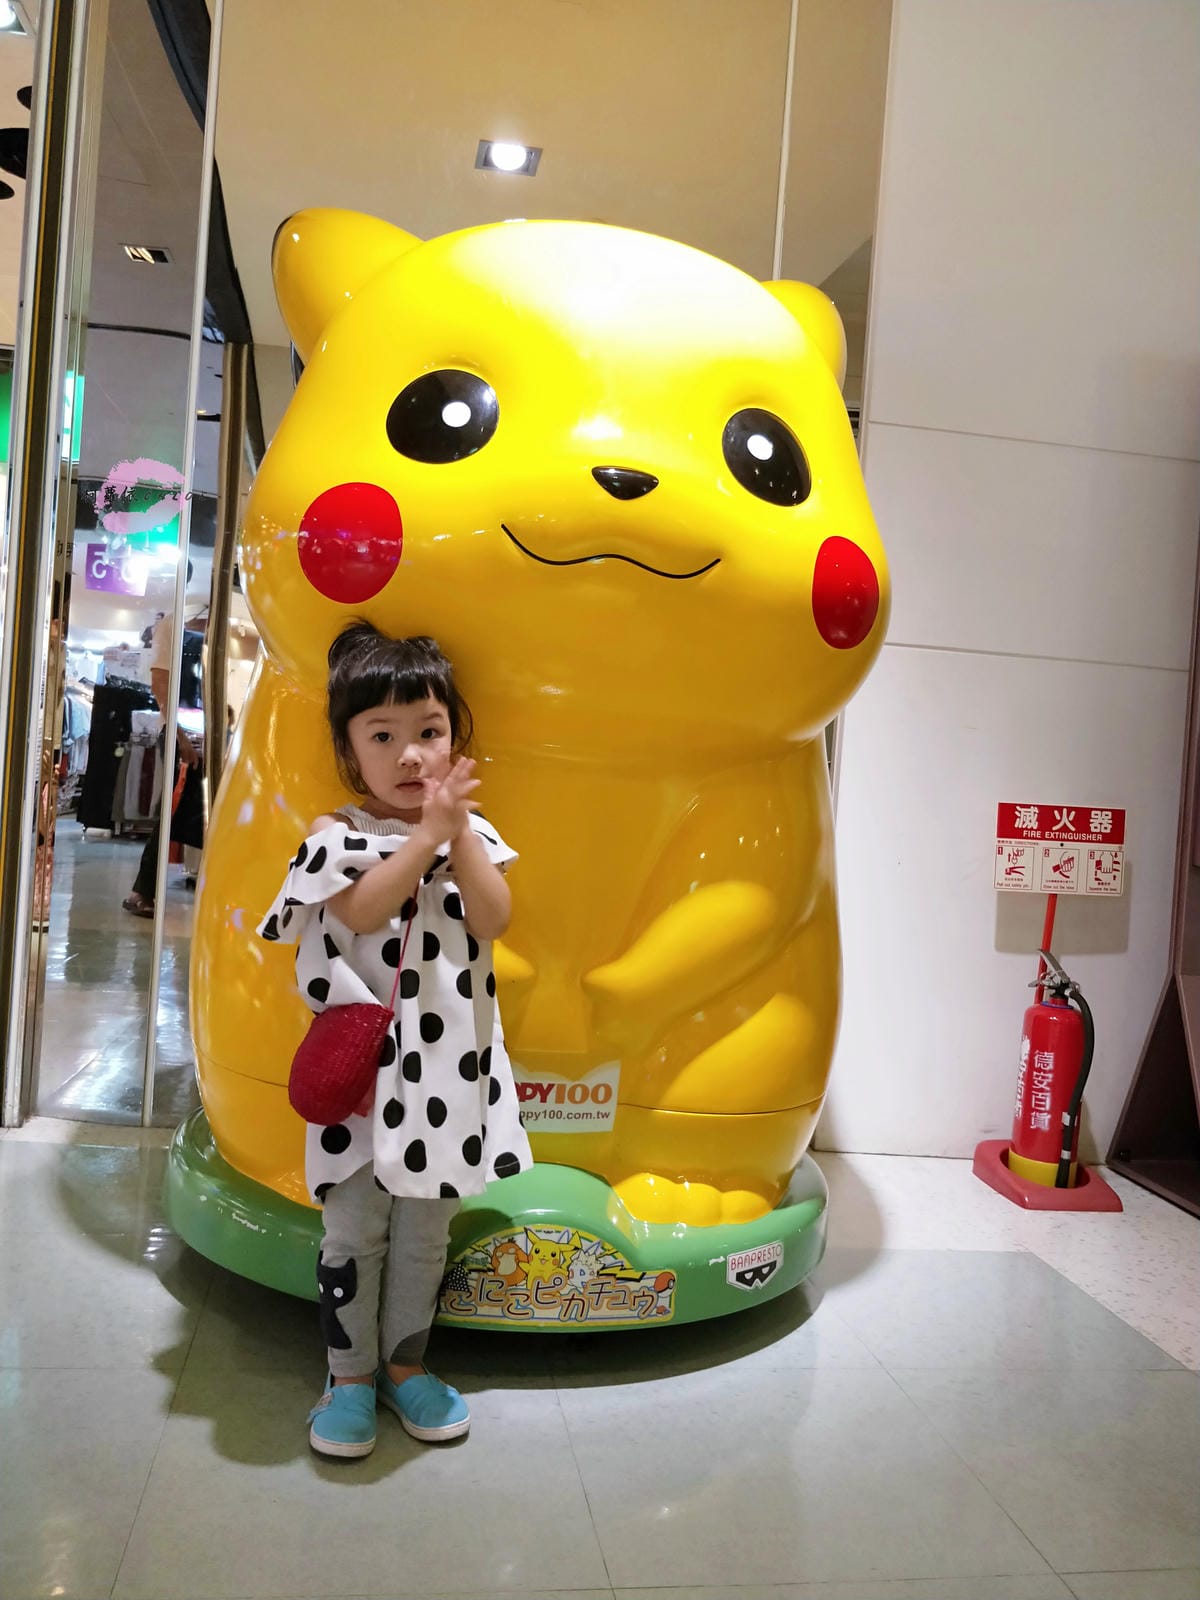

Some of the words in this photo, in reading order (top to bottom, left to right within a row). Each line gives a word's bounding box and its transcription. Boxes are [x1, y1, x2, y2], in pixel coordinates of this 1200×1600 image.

[1014, 805, 1113, 833] 滅火器
[1023, 830, 1042, 839] FIRE
[1045, 831, 1103, 841] EXTINGUISHER
[1030, 1050, 1055, 1130] 德安百貨
[730, 1244, 783, 1271] BANPRESTO
